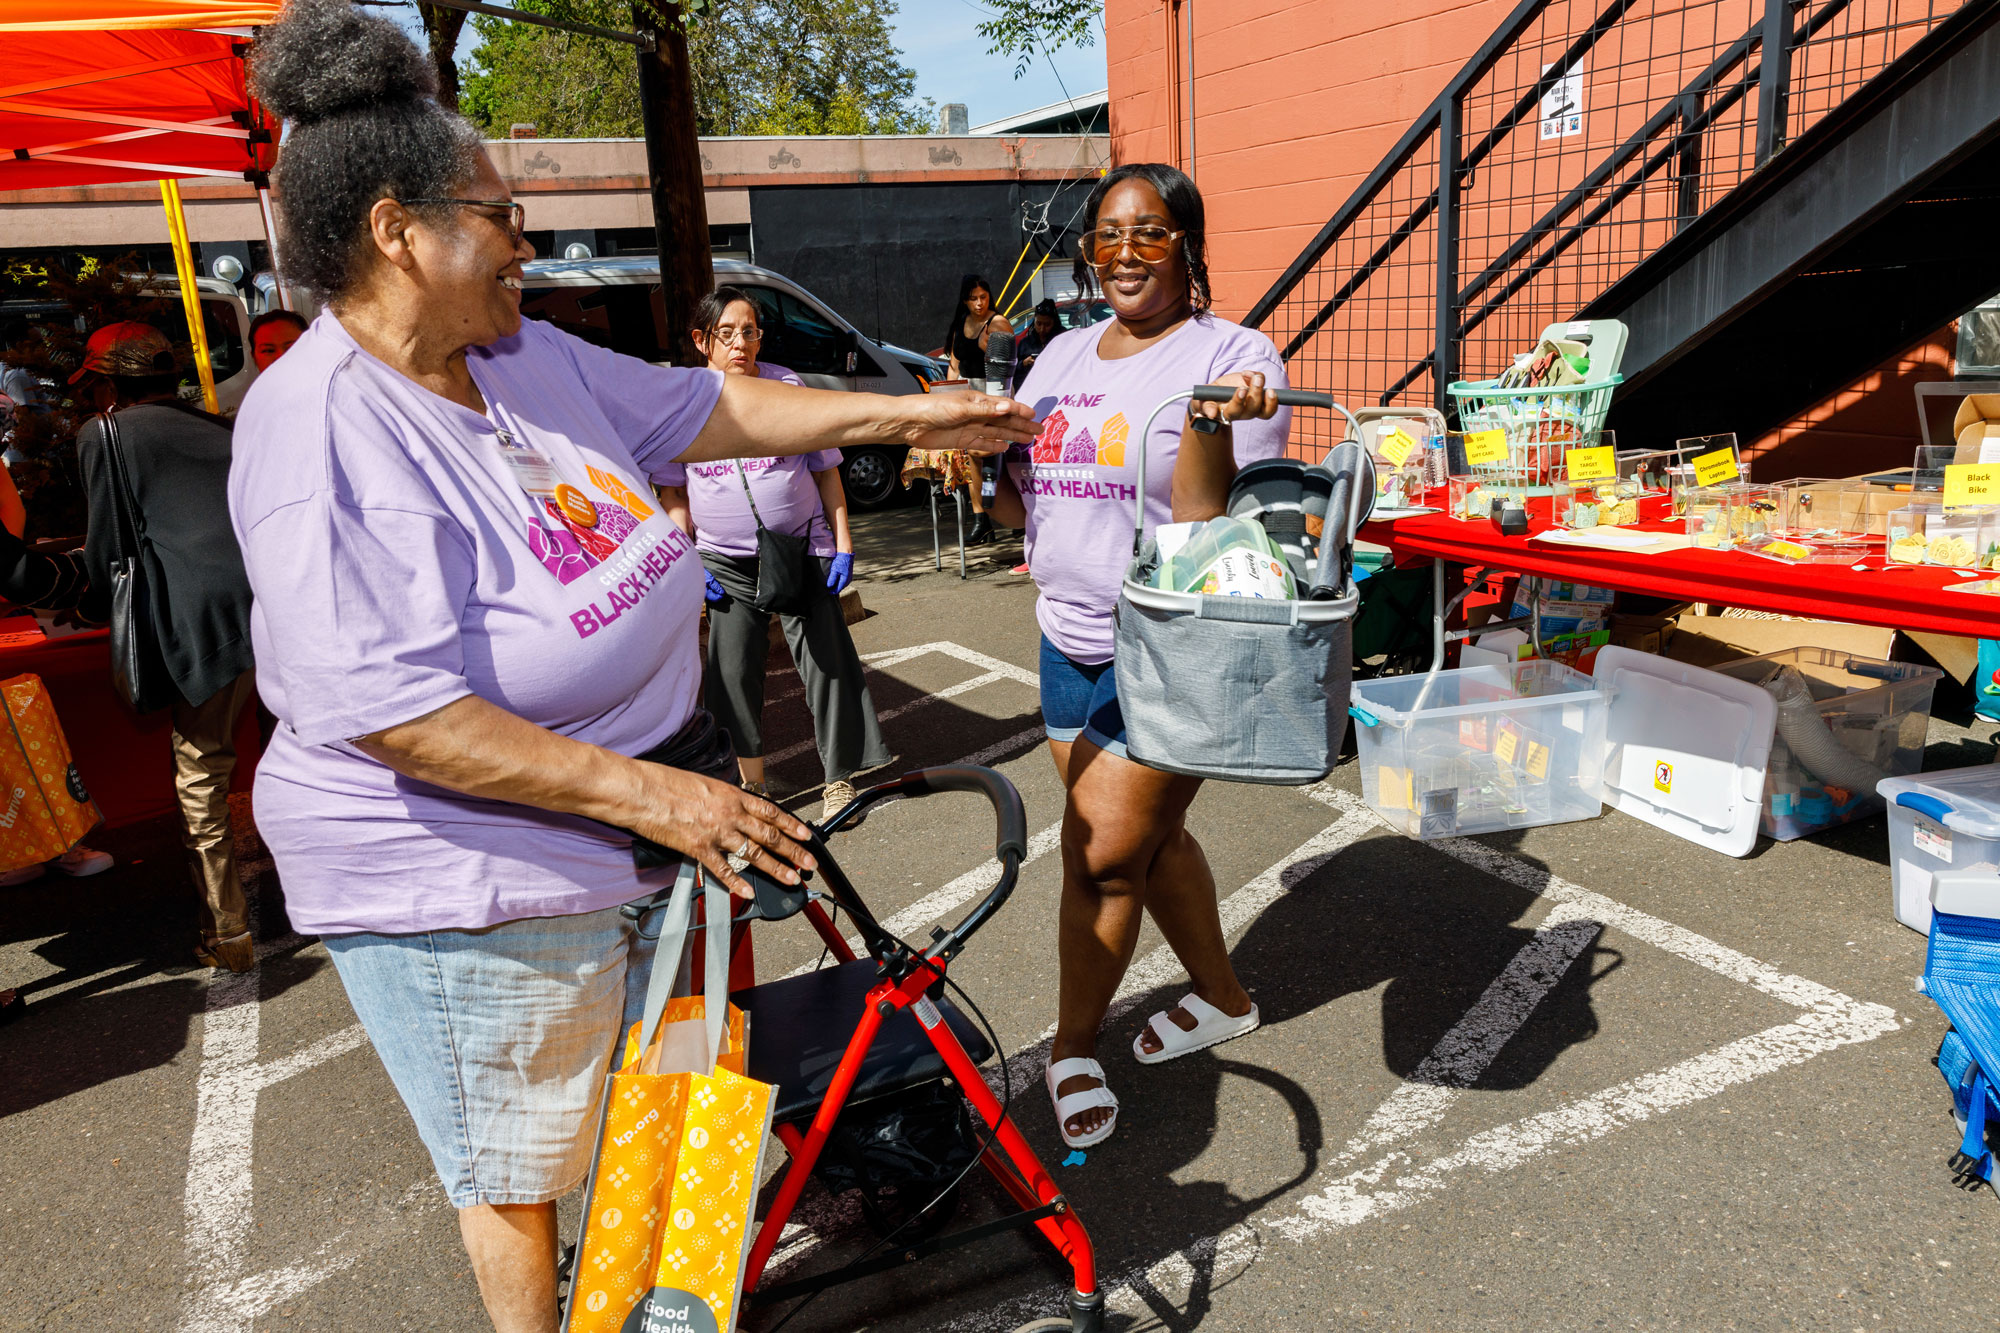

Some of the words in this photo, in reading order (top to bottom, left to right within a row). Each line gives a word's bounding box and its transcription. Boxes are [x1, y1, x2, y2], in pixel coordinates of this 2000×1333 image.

[1021, 468, 1095, 479] CELEBRATES
[1700, 459, 1730, 472] Chromebook
[1709, 470, 1726, 478] Laptop
[1967, 473, 1991, 482] Black
[1019, 479, 1056, 497] ACK
[1058, 480, 1137, 500] HEALTH
[1968, 486, 1988, 494] Bike
[599, 531, 657, 586] CELEBRATES
[569, 572, 650, 639] BLACK
[613, 1108, 659, 1147] kp.org
[644, 1298, 690, 1321] Good
